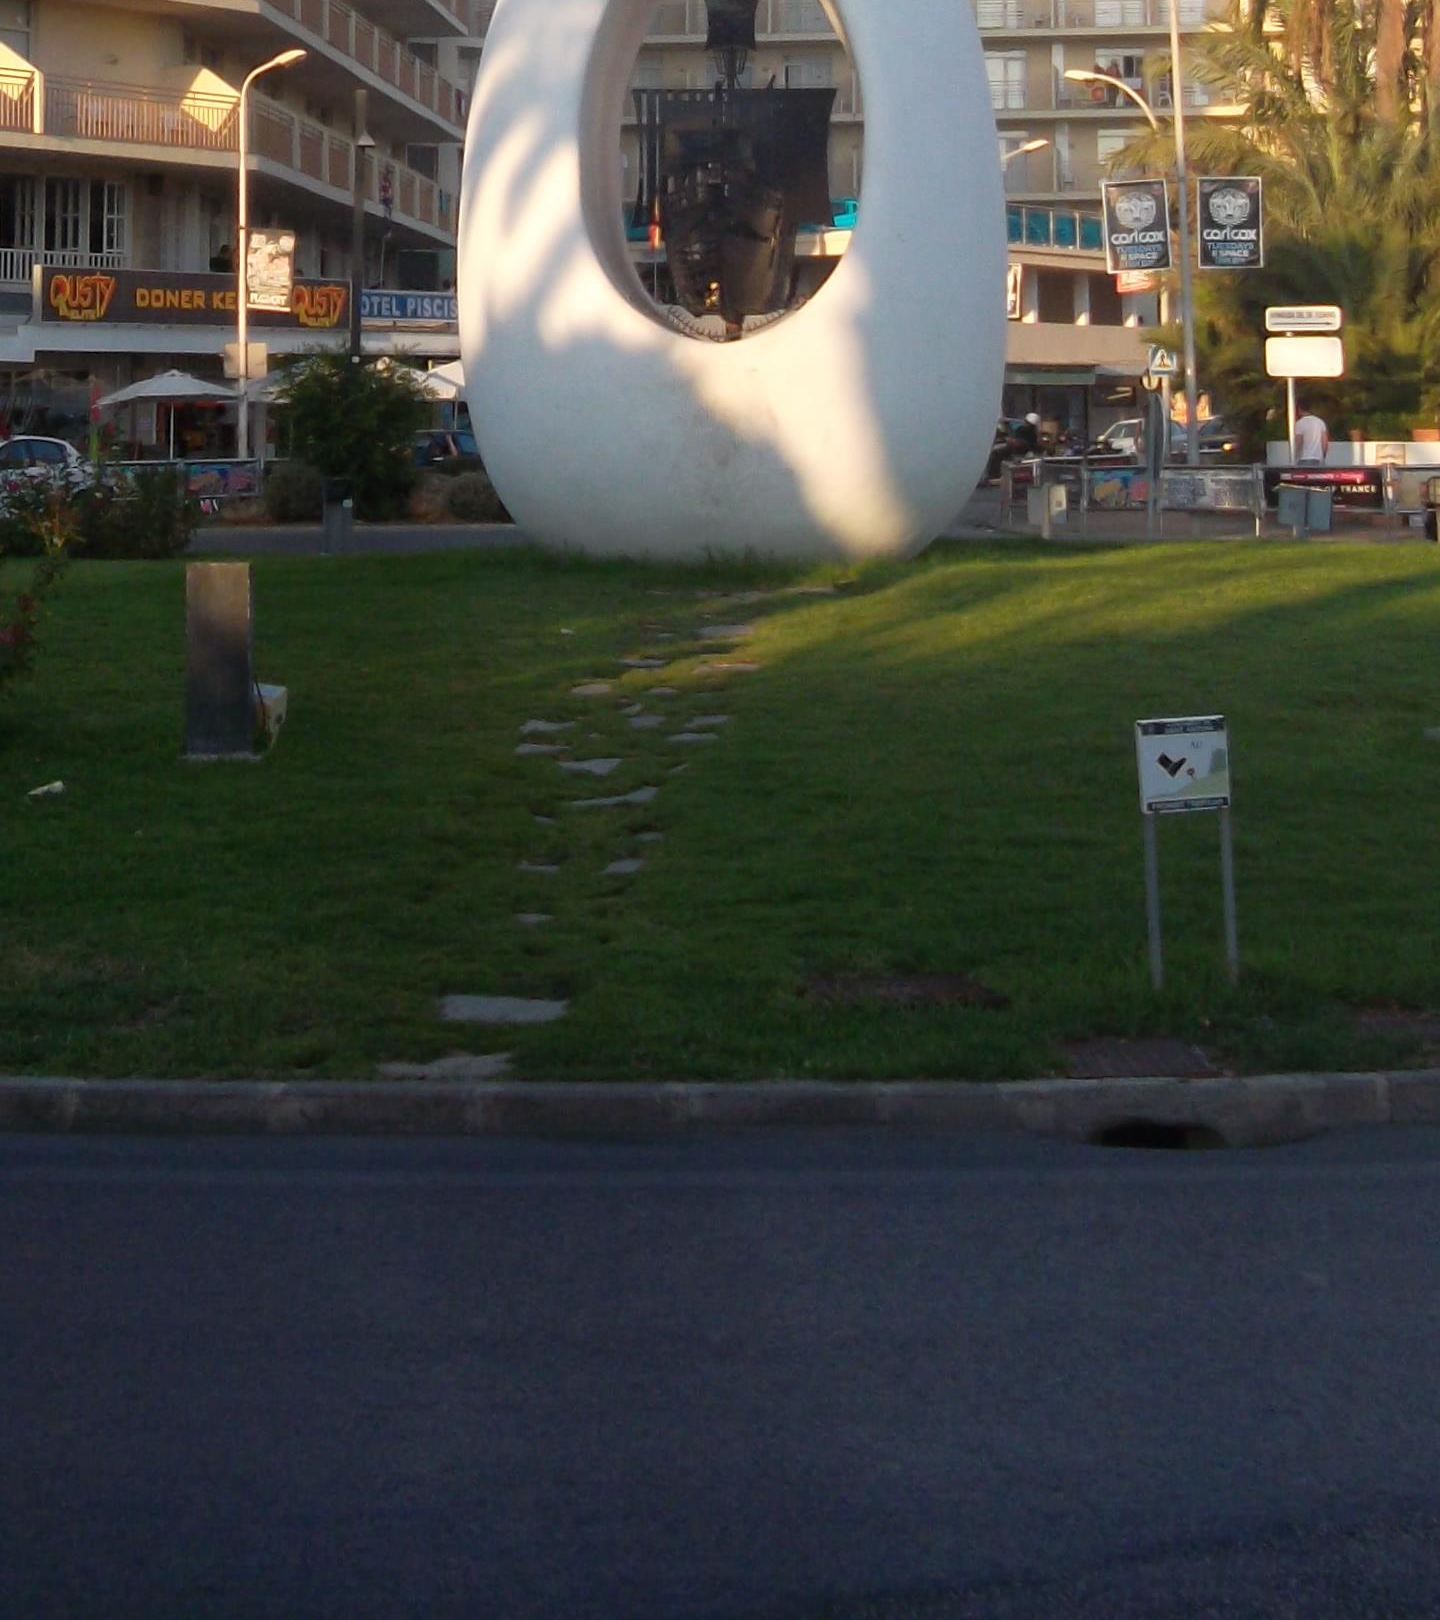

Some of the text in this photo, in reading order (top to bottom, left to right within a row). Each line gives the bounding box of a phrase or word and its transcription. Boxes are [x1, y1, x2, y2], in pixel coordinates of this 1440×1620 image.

[135, 287, 206, 310] DONER
[212, 290, 238, 310] KE
[360, 294, 401, 317] OTEL
[1339, 484, 1377, 493] TRANCE
